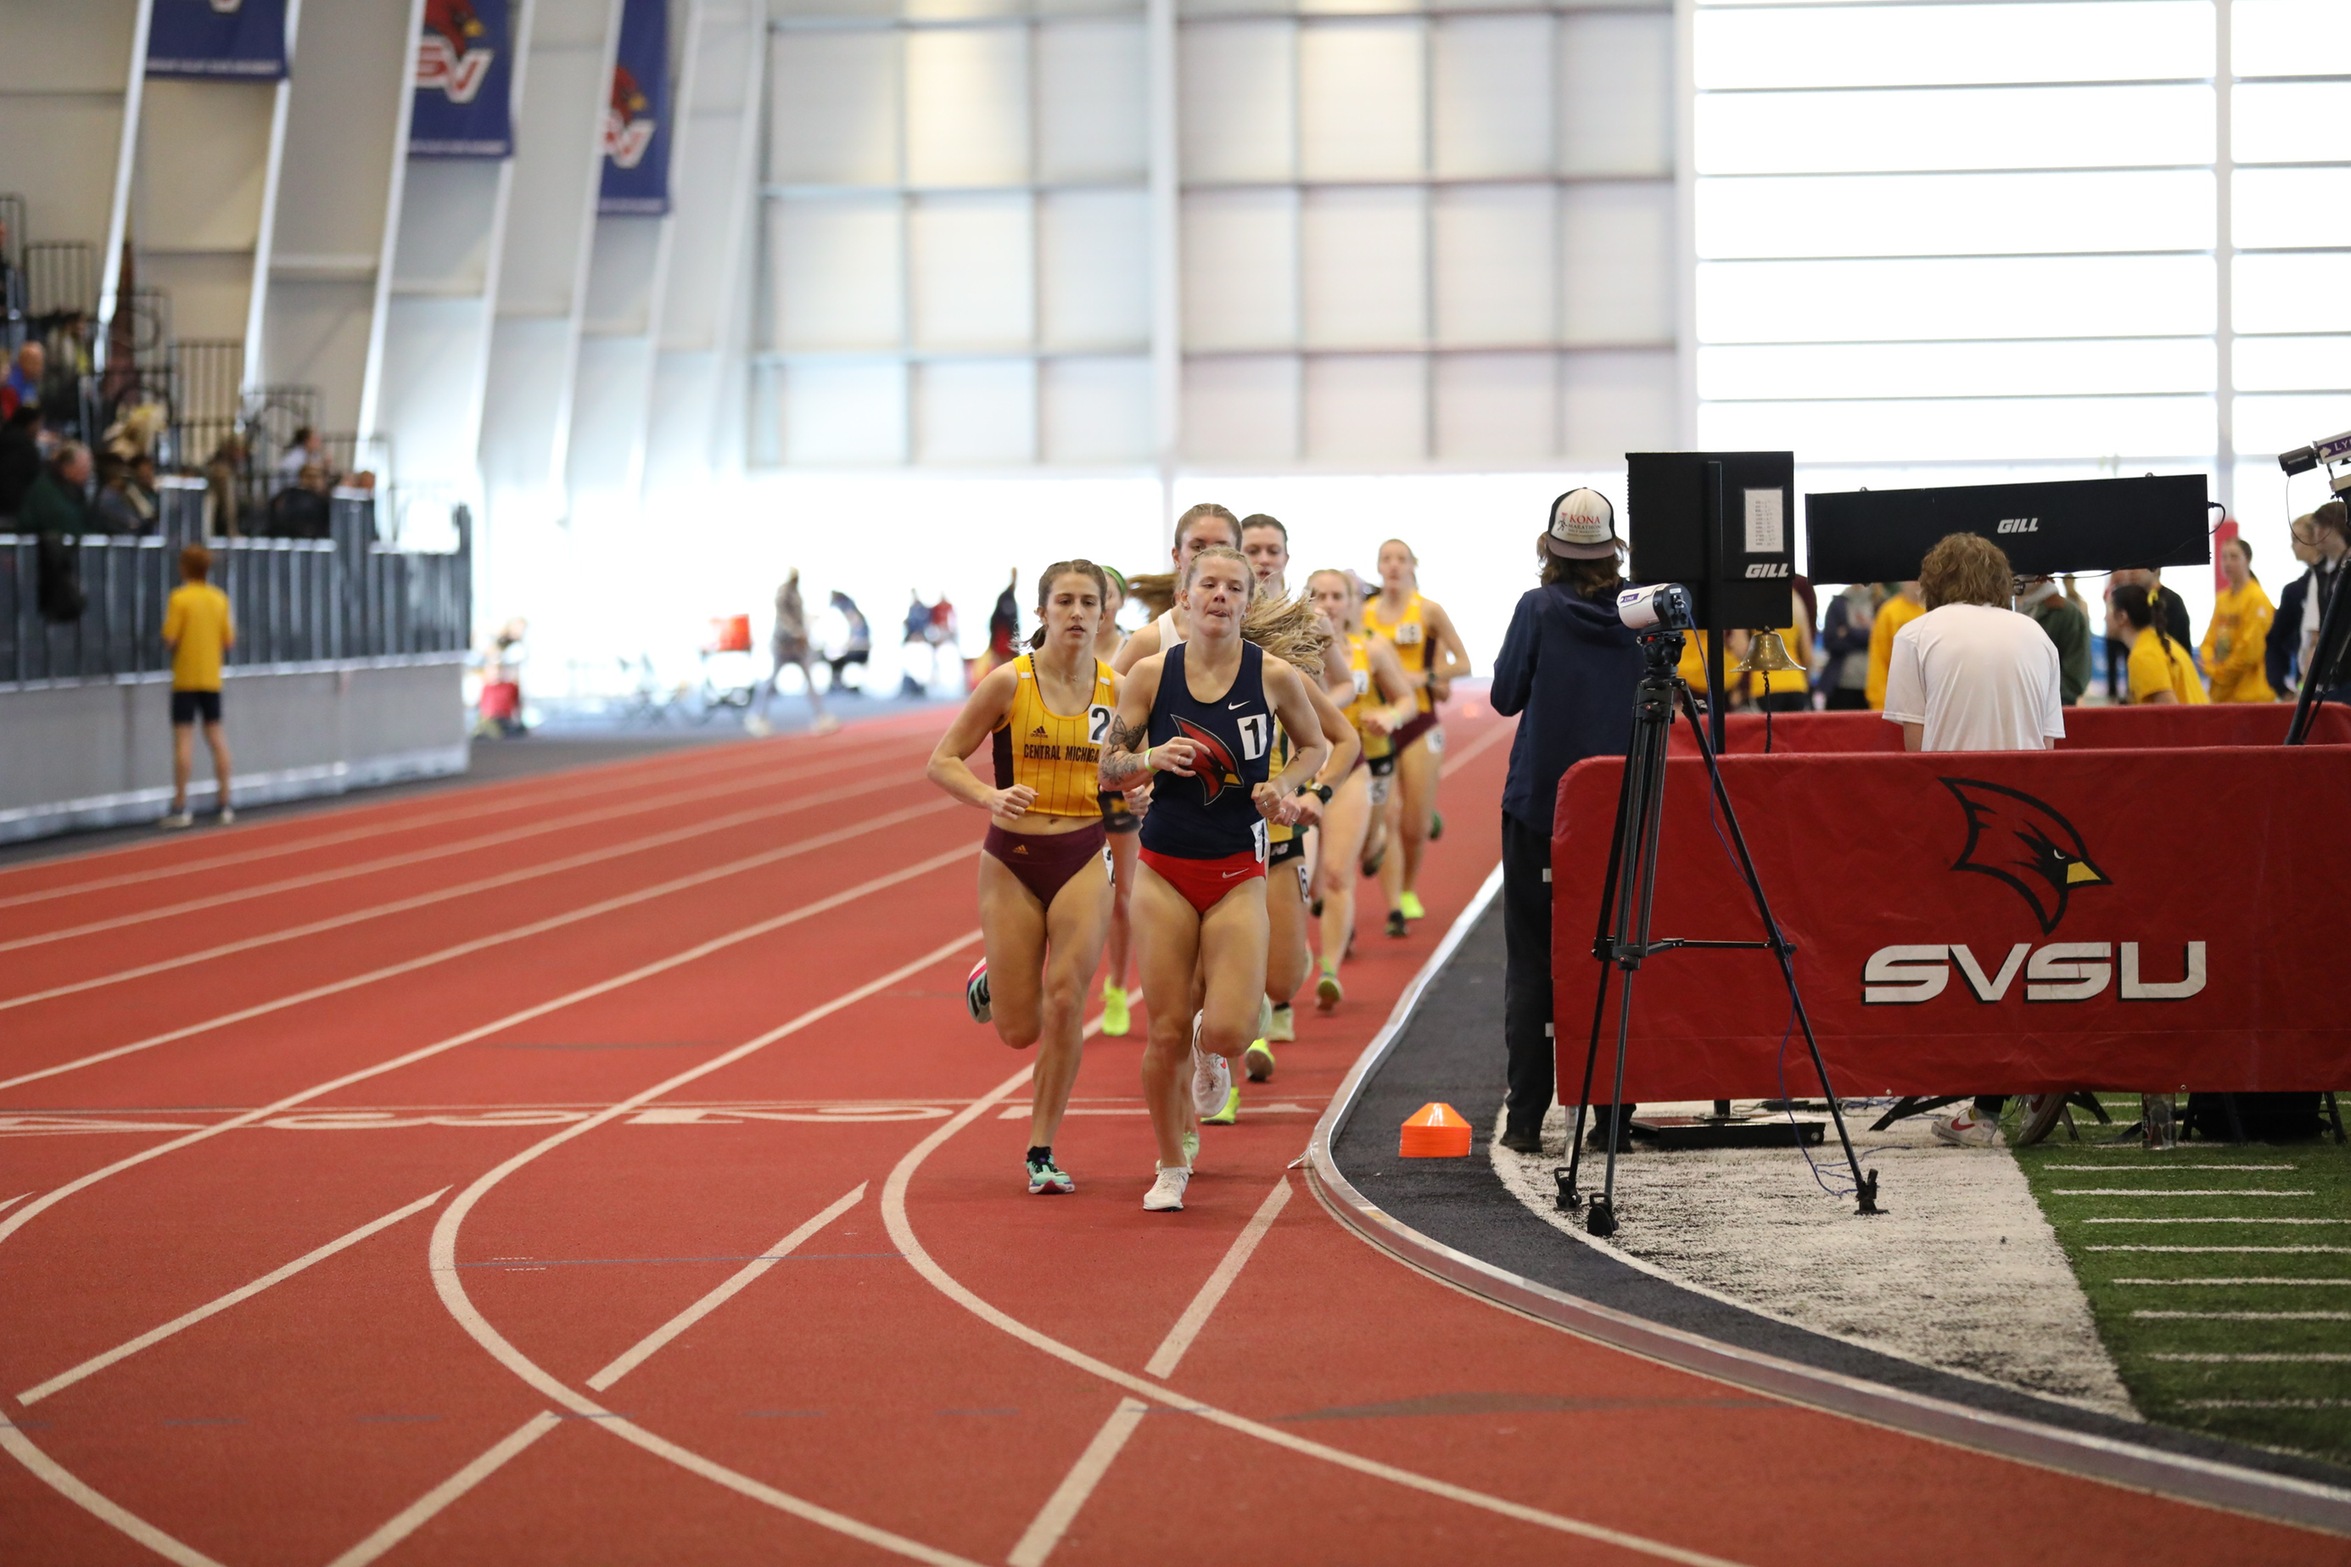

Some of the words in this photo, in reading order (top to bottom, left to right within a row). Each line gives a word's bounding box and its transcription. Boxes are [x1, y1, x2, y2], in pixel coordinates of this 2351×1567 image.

[2334, 438, 2351, 451] LY
[1569, 514, 1601, 525] KONA
[1997, 517, 2039, 534] GILL
[1745, 563, 1789, 579] GILL
[1091, 707, 1111, 741] 2
[1244, 719, 1261, 755] 1
[1024, 744, 1061, 760] CENTRAL
[1065, 745, 1100, 764] MICHIGA
[1862, 940, 2207, 1005] SVSU
